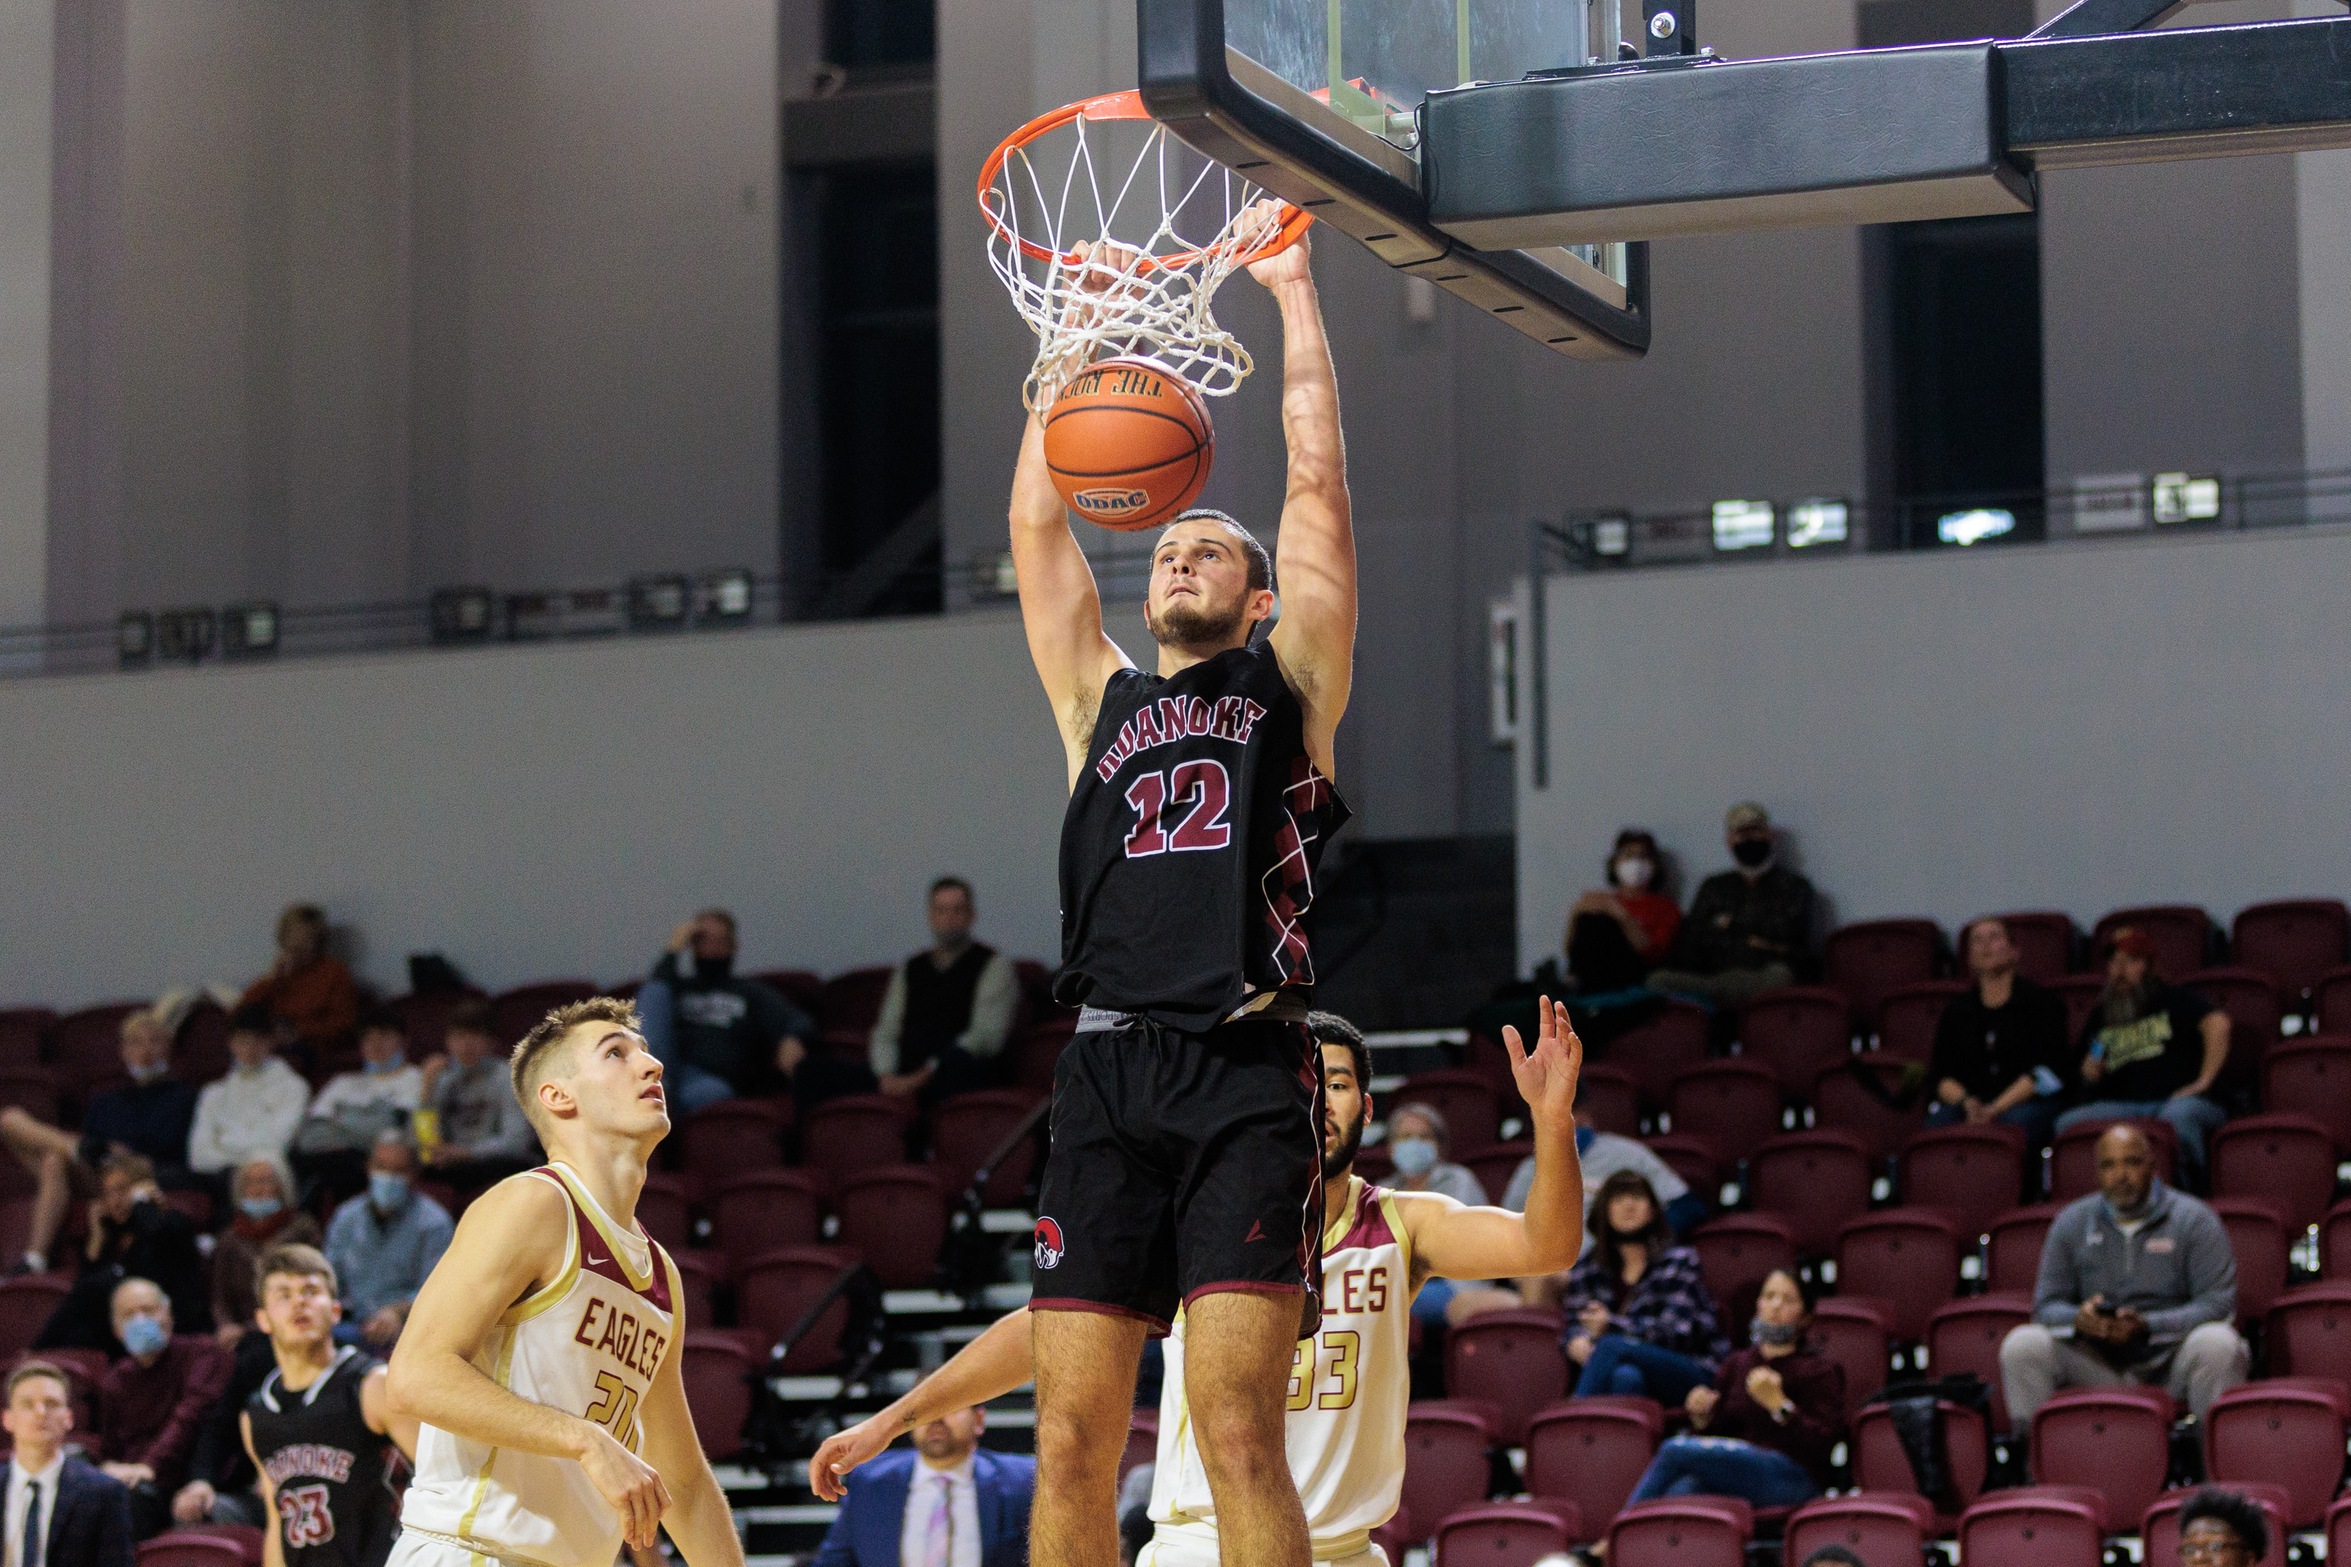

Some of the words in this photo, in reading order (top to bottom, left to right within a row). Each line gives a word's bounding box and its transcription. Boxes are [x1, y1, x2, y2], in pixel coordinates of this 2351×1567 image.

[1111, 369, 1163, 398] THE
[1075, 490, 1147, 509] ODAC
[1124, 759, 1231, 859] 12
[1321, 1267, 1387, 1315] LES
[574, 1297, 667, 1383] EAGLES
[276, 1483, 335, 1548] 23
